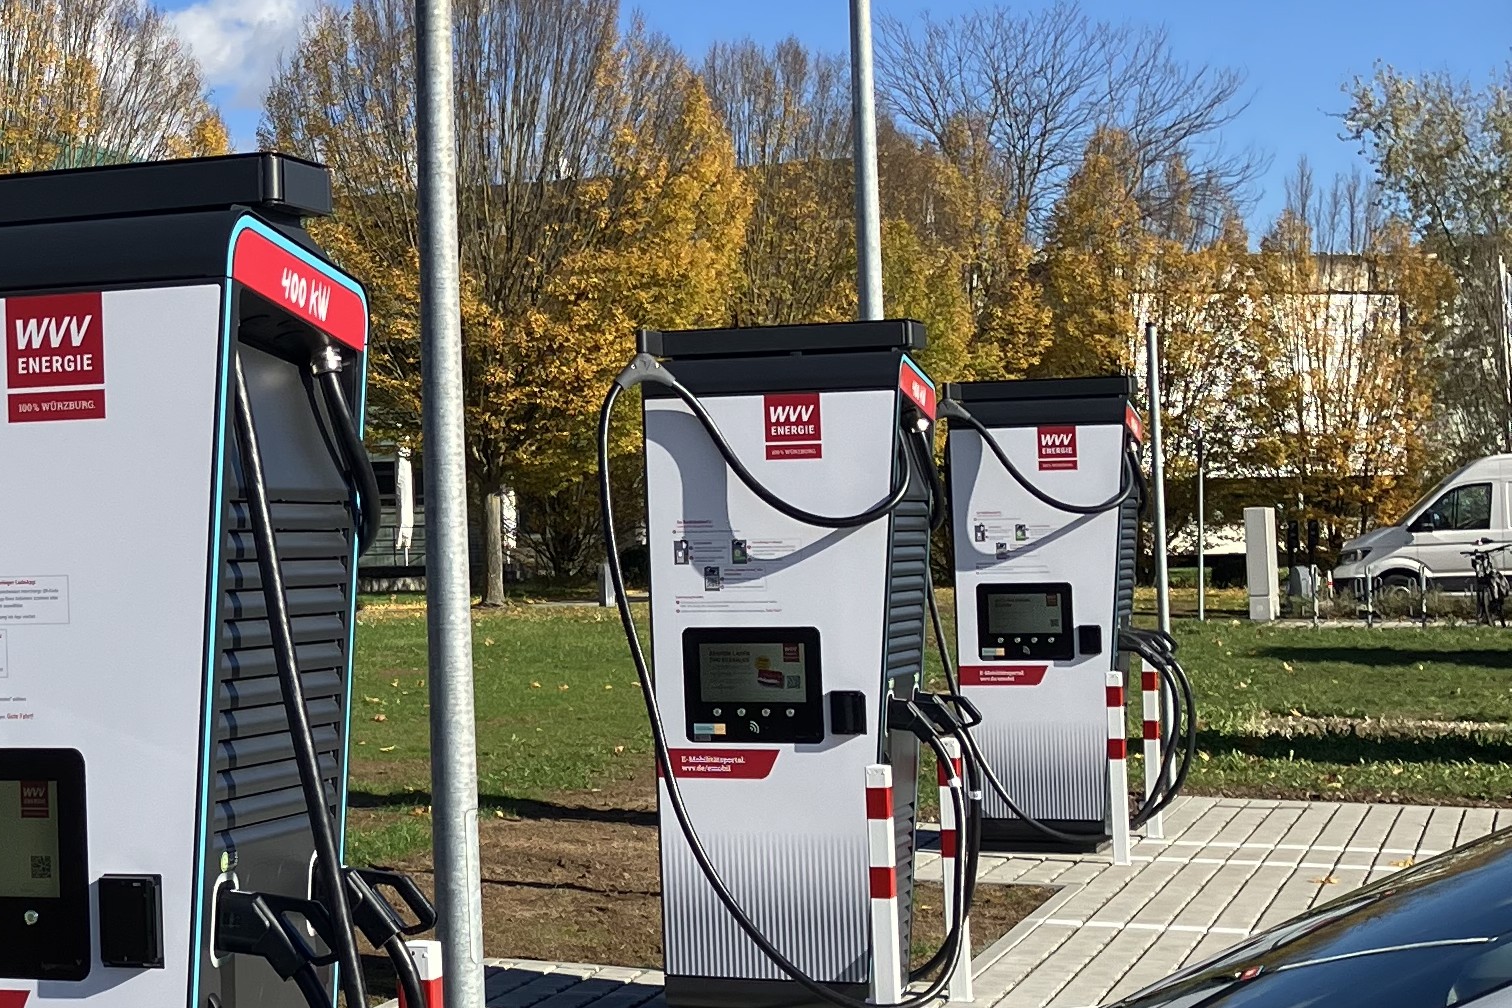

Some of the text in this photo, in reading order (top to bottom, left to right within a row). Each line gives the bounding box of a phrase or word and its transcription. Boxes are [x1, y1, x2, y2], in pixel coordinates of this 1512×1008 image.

[281, 266, 331, 322] 400 kW
[15, 315, 92, 350] WVV
[18, 354, 93, 374] ENERGIE
[769, 404, 814, 423] WVV
[771, 425, 815, 436] ENERGIE
[1041, 433, 1073, 446] WVV
